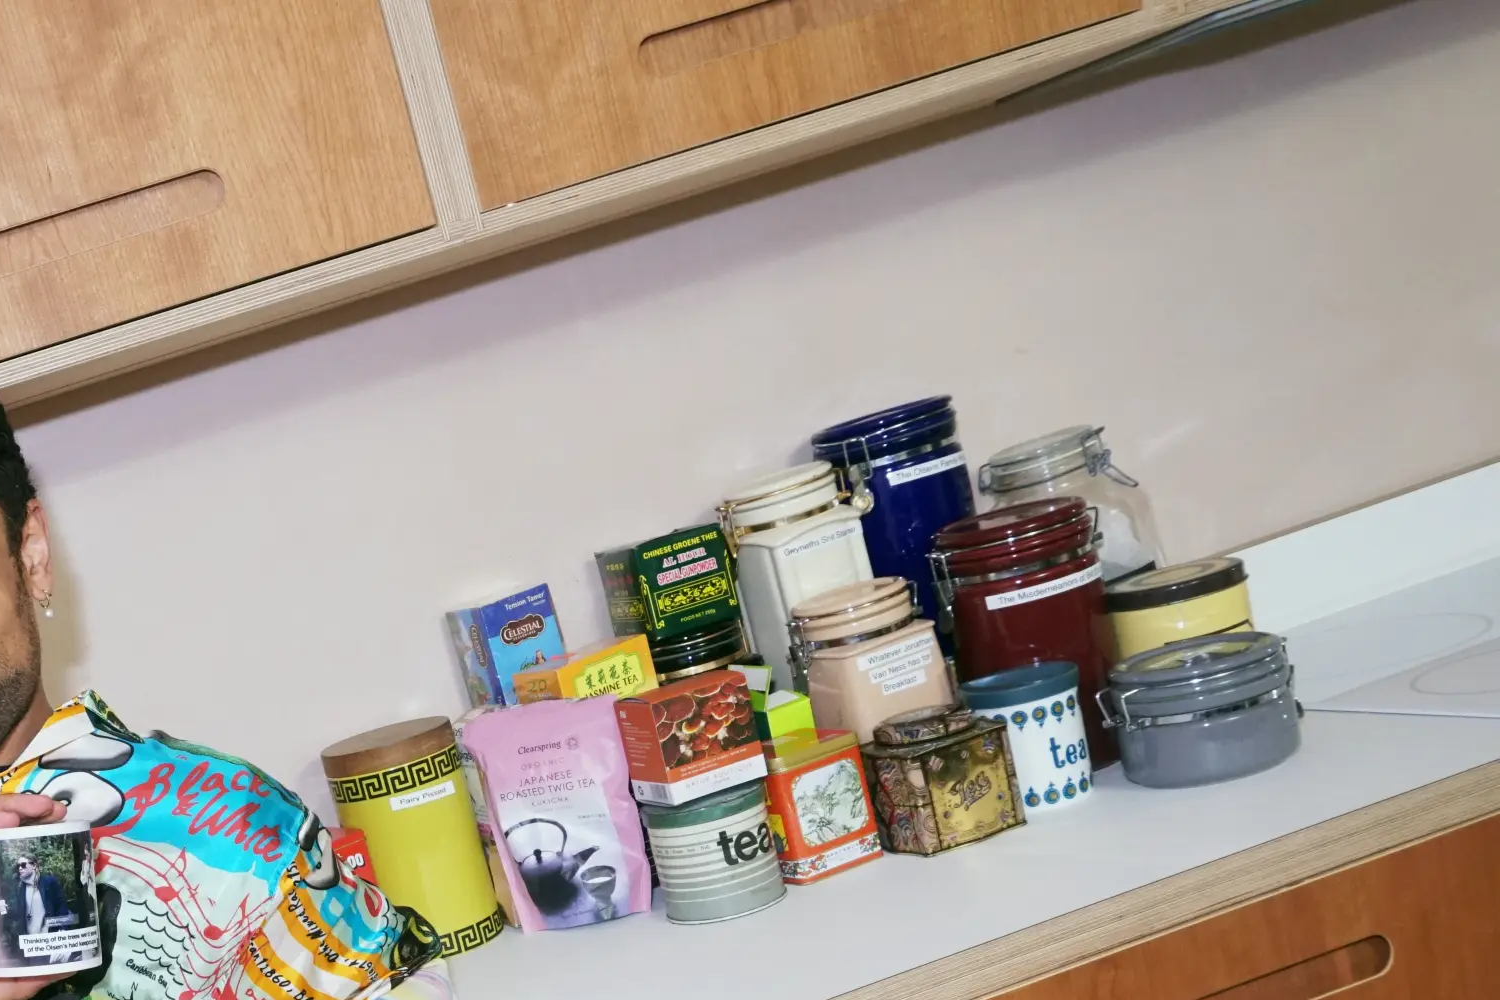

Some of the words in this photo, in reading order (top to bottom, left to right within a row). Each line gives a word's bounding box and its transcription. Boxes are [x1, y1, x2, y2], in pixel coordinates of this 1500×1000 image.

[643, 544, 673, 560] CHINESE
[672, 537, 701, 550] GROENE
[700, 530, 718, 542] THEE
[657, 567, 681, 585] SPECIAL
[681, 558, 718, 578] GUNPOWDER
[663, 556, 677, 568] AL
[504, 599, 527, 611] Tension
[527, 591, 545, 603] Tamer
[998, 594, 1015, 605] The
[1017, 578, 1078, 602] Misdemeanors
[503, 620, 542, 641] CELESTIAL
[867, 648, 902, 665] Whatever
[903, 636, 934, 652] Jonathan
[585, 659, 632, 689] 茉莉花茶
[872, 669, 887, 680] Van
[888, 663, 907, 676] Ness
[907, 658, 921, 670] has
[921, 653, 931, 664] for
[526, 679, 547, 692] 20
[623, 674, 639, 685] TEA
[883, 675, 918, 692] Breakfast
[517, 740, 562, 754] Clearspring
[1050, 736, 1087, 769] tea
[132, 761, 271, 806] Black
[519, 770, 573, 787] JAPANESE
[399, 795, 421, 805] Fairy
[422, 787, 447, 800] Pissed
[500, 787, 545, 802] ROASTED
[548, 782, 575, 793] TWIG
[578, 778, 596, 789] TEA
[531, 796, 569, 806] KUKICHA
[187, 801, 283, 863] White
[717, 822, 773, 866] tea
[23, 937, 50, 945] Thinking
[57, 934, 67, 942] the
[46, 942, 68, 951] Olsen's
[69, 941, 78, 949] had
[125, 958, 157, 980] Caribbean
[157, 974, 168, 989] Sea
[107, 990, 115, 999] W
[131, 981, 139, 991] N
